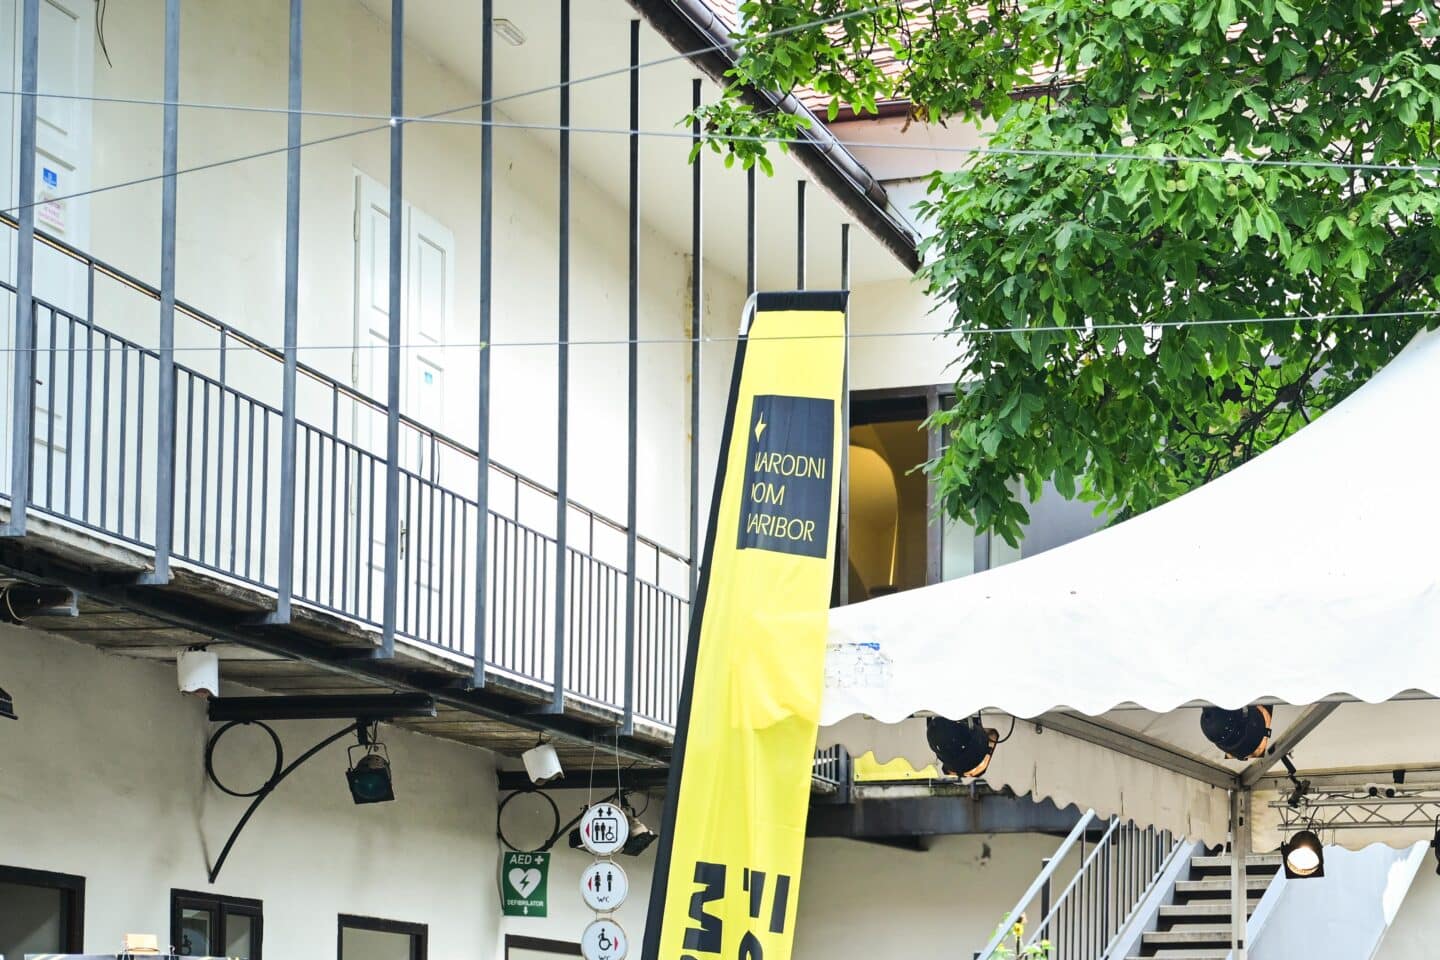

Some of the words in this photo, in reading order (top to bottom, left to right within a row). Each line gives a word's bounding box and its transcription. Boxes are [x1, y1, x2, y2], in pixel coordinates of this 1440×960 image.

[751, 482, 785, 506] OM
[509, 855, 532, 865] AED
[507, 899, 544, 908] DEFIBRILATOR
[596, 896, 611, 904] WC
